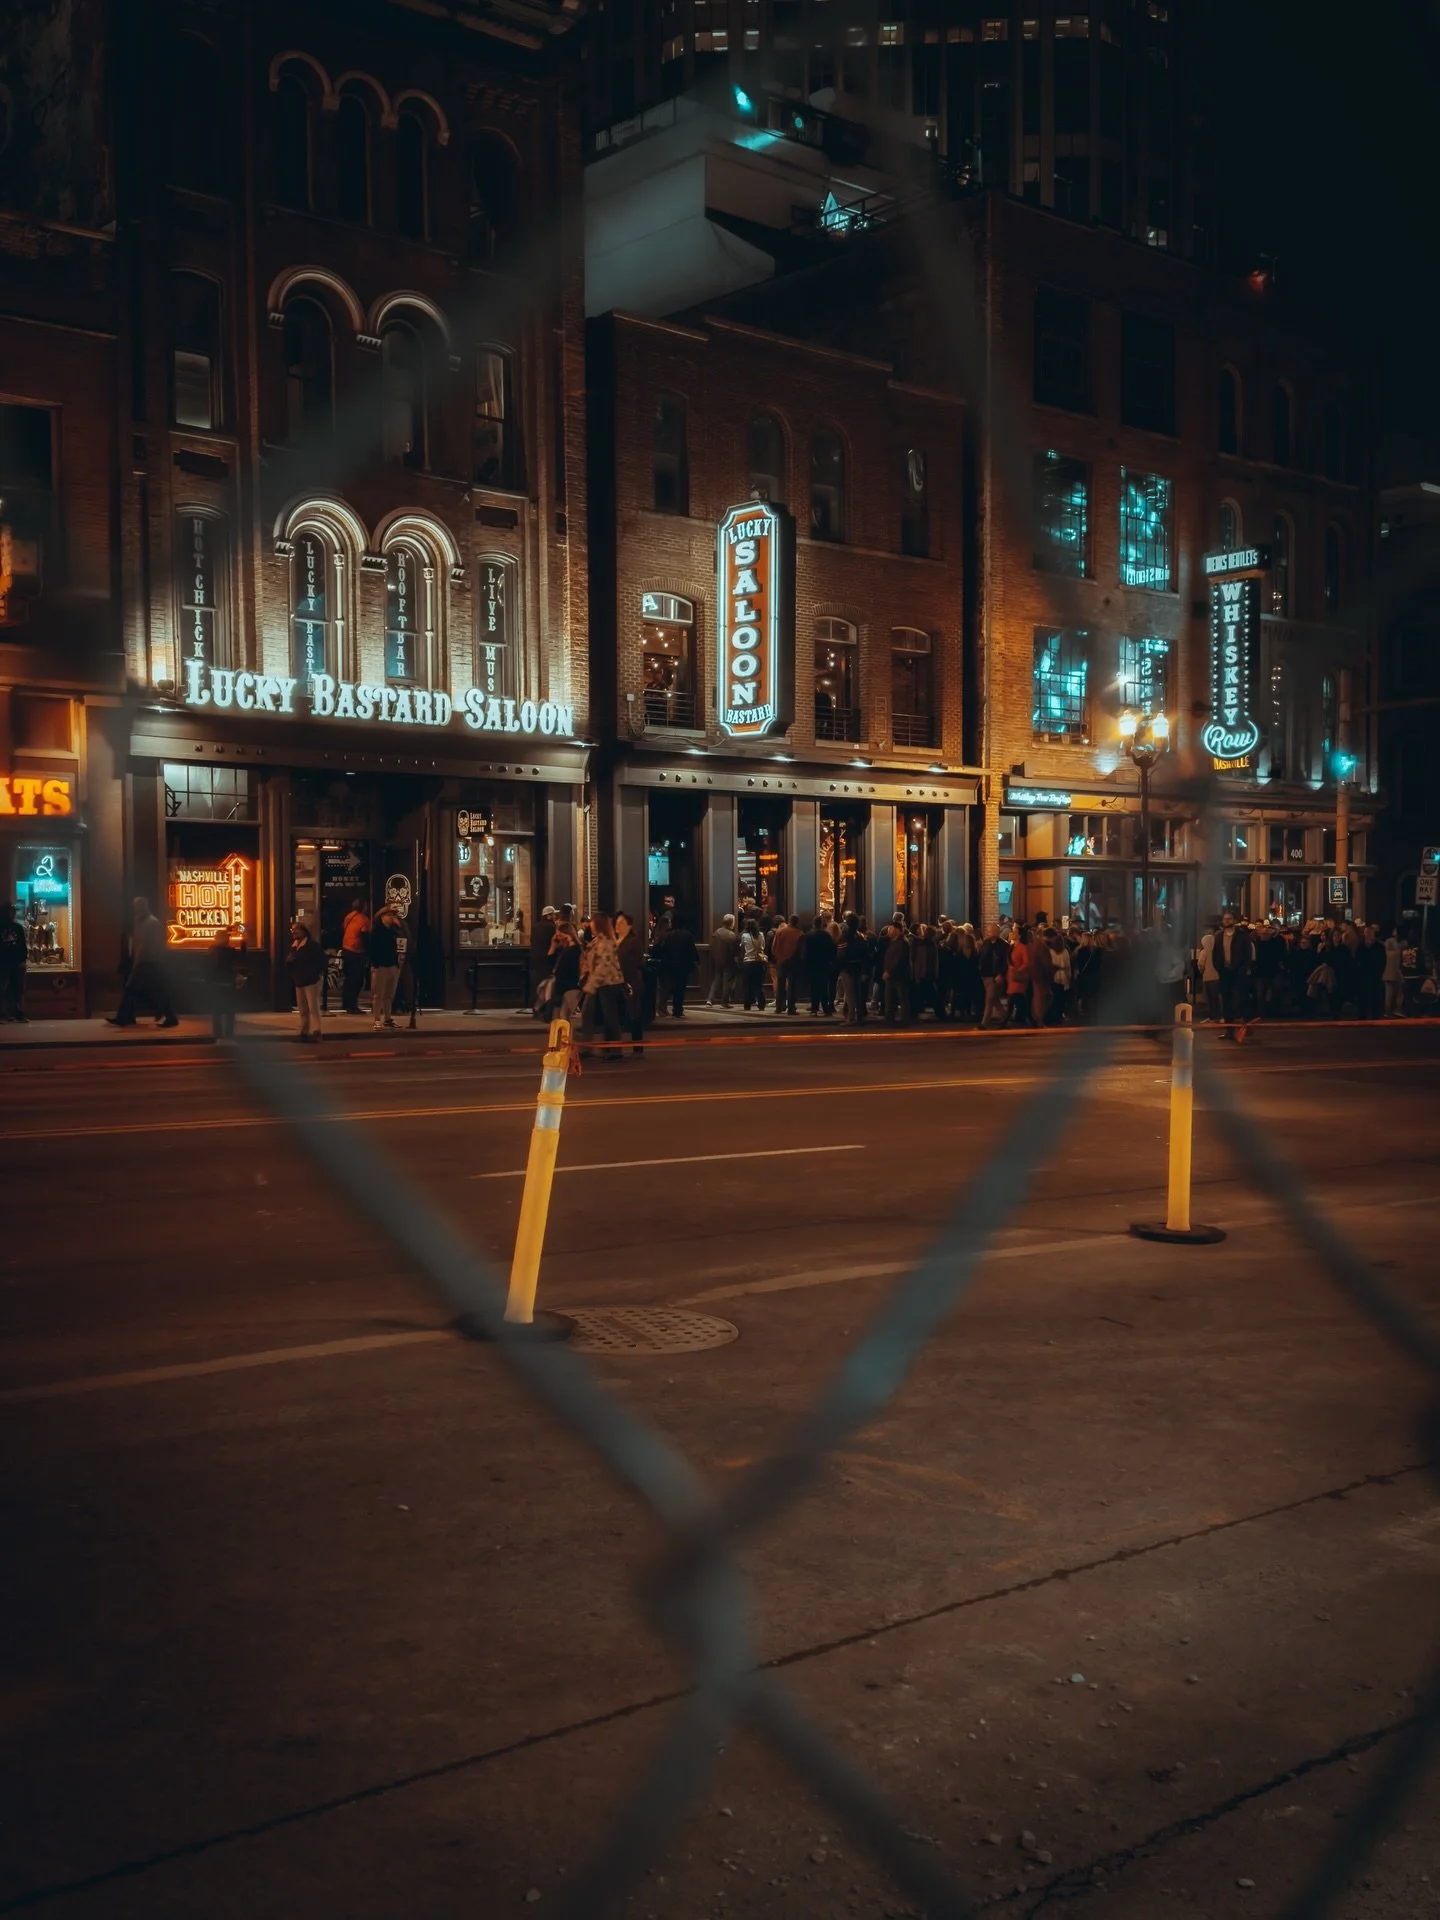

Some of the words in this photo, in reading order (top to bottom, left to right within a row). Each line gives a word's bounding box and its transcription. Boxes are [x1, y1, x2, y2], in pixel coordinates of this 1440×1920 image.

[193, 519, 205, 568] HOT
[728, 519, 772, 544] LUCKY
[306, 541, 316, 611] LUCKY
[487, 568, 496, 632] LIVE
[731, 540, 760, 706] SALOON
[1221, 582, 1243, 726] WHISKEY
[185, 659, 298, 713] LUCKY
[311, 673, 452, 727] BASTARD
[464, 688, 574, 737] SALOON
[726, 703, 774, 724] BASTARD
[1208, 725, 1254, 754] Row
[1290, 849, 1303, 859] 400
[178, 870, 230, 883] NASHVILLE
[1419, 878, 1434, 887] ONE
[178, 883, 231, 908] HOT
[178, 909, 230, 926] CHICKEN
